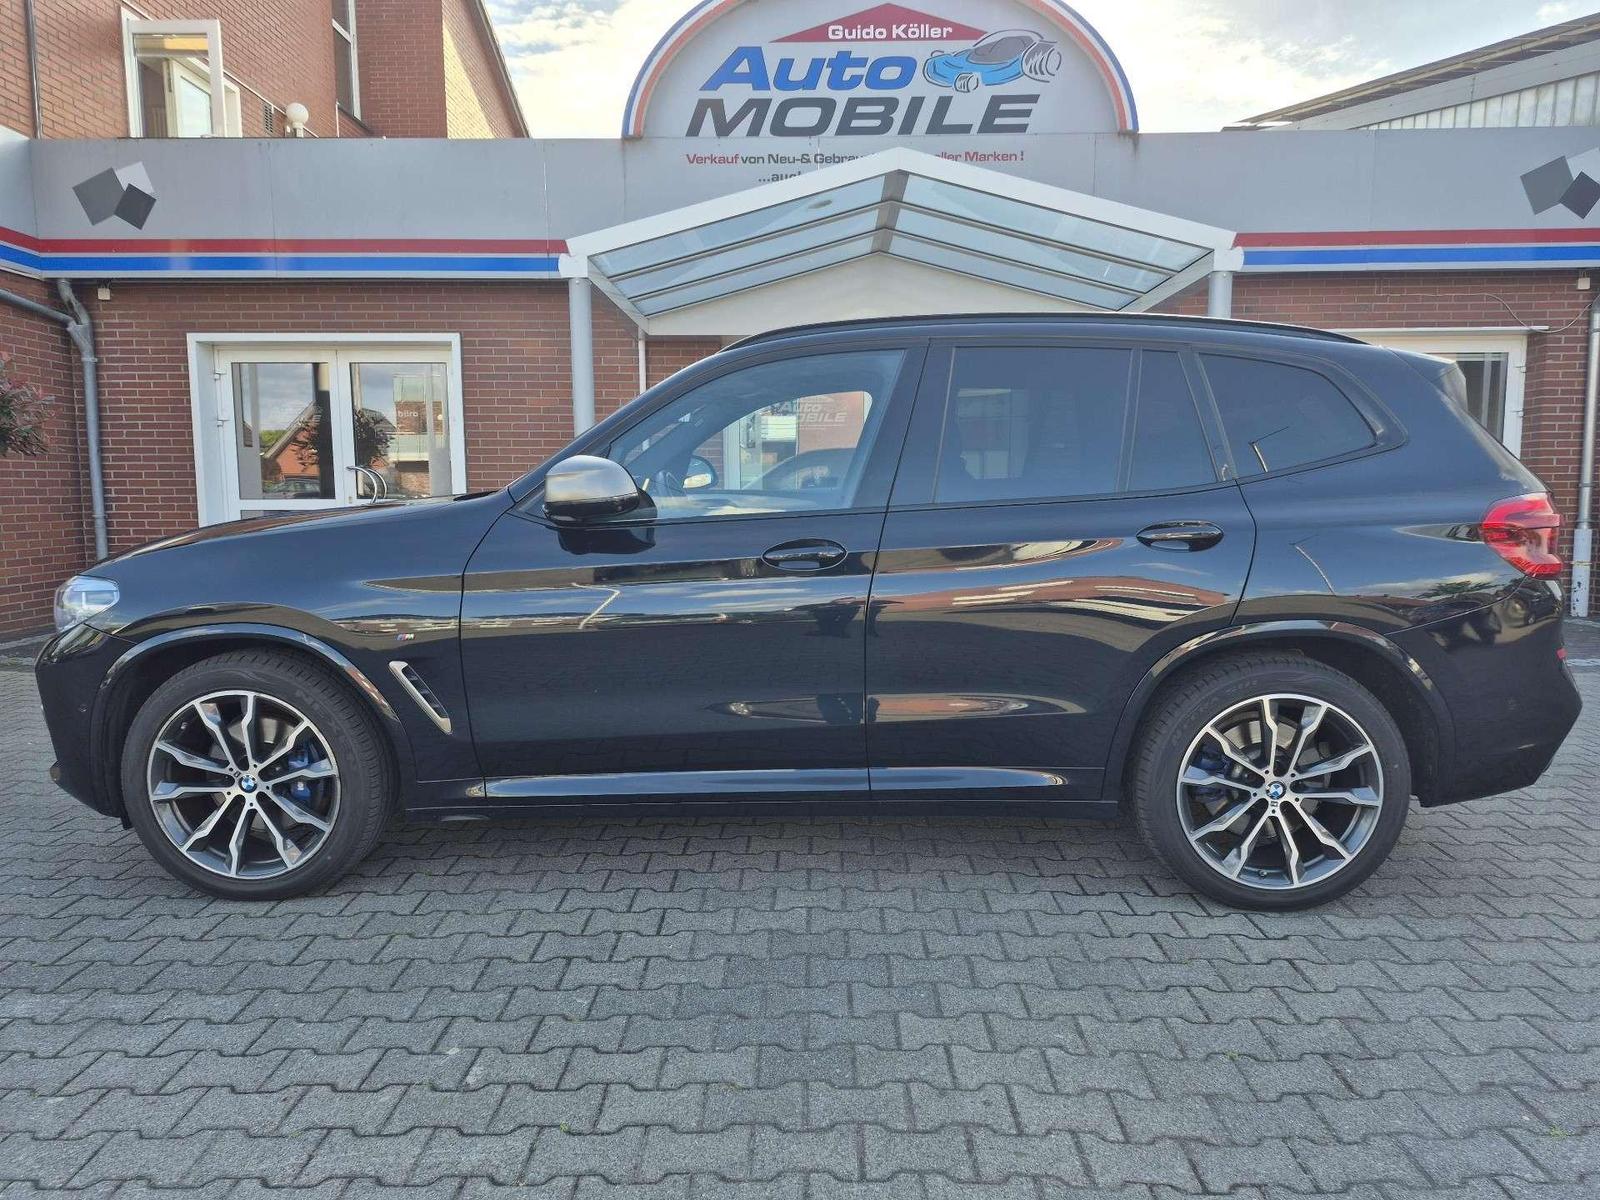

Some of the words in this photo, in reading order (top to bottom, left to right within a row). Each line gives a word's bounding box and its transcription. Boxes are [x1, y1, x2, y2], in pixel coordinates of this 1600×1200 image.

[828, 25, 887, 40] Guido
[892, 24, 953, 39] Köller
[699, 46, 917, 91] Auto
[685, 94, 1040, 137] MOBILE
[686, 153, 739, 164] Verkauf
[741, 156, 765, 164] von
